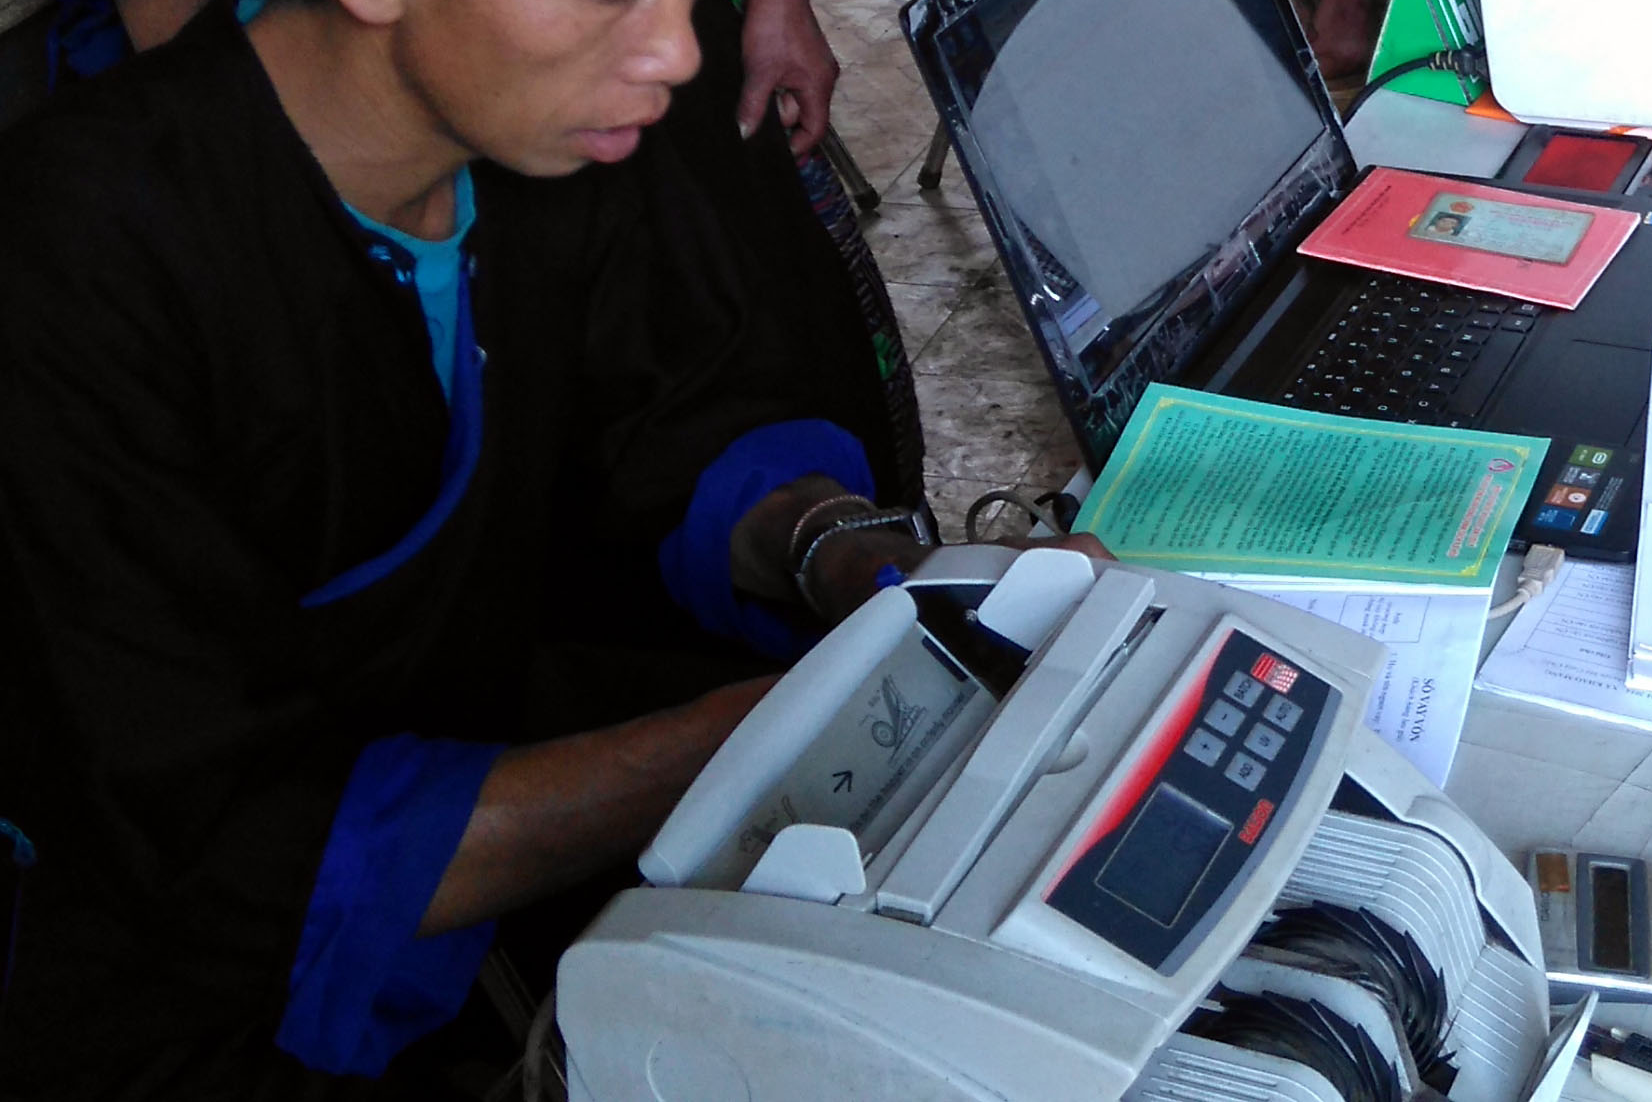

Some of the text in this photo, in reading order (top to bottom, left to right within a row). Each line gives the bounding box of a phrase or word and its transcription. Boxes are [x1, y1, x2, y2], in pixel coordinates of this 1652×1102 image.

[1409, 678, 1436, 742] SỔ VAY VỐN
